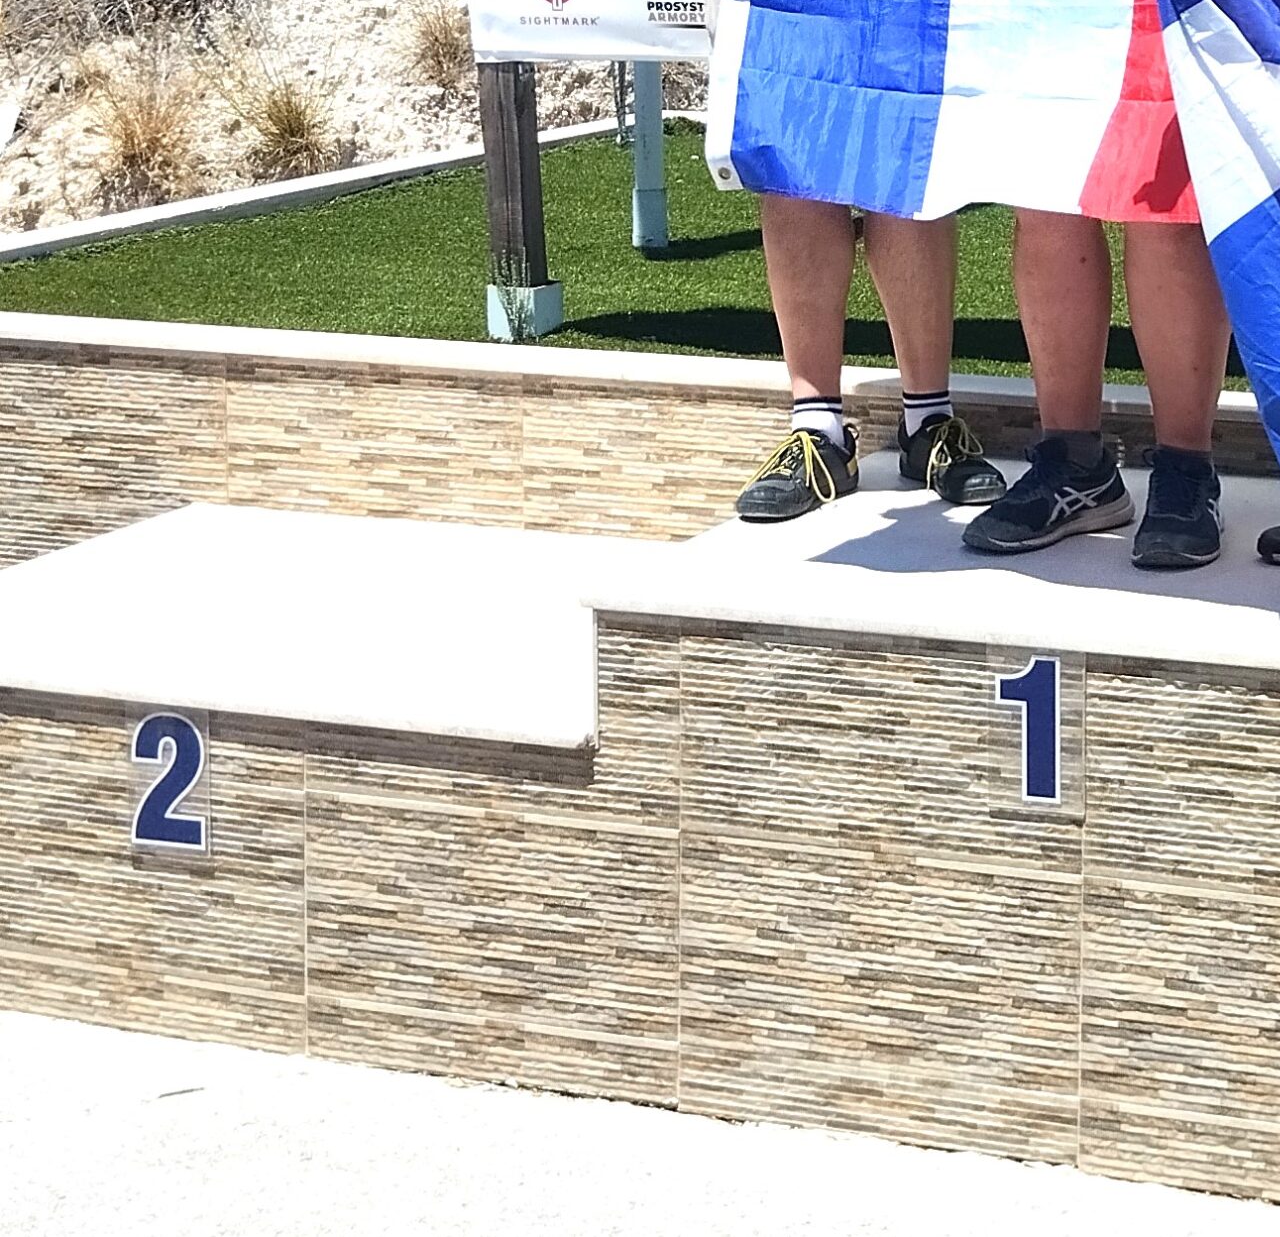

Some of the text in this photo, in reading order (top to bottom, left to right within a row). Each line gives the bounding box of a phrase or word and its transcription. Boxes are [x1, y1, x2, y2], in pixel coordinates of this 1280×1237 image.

[519, 16, 598, 27] SIGHTMARK
[647, 1, 706, 12] PROSYST
[994, 655, 1061, 805] 1
[131, 711, 206, 851] 2
